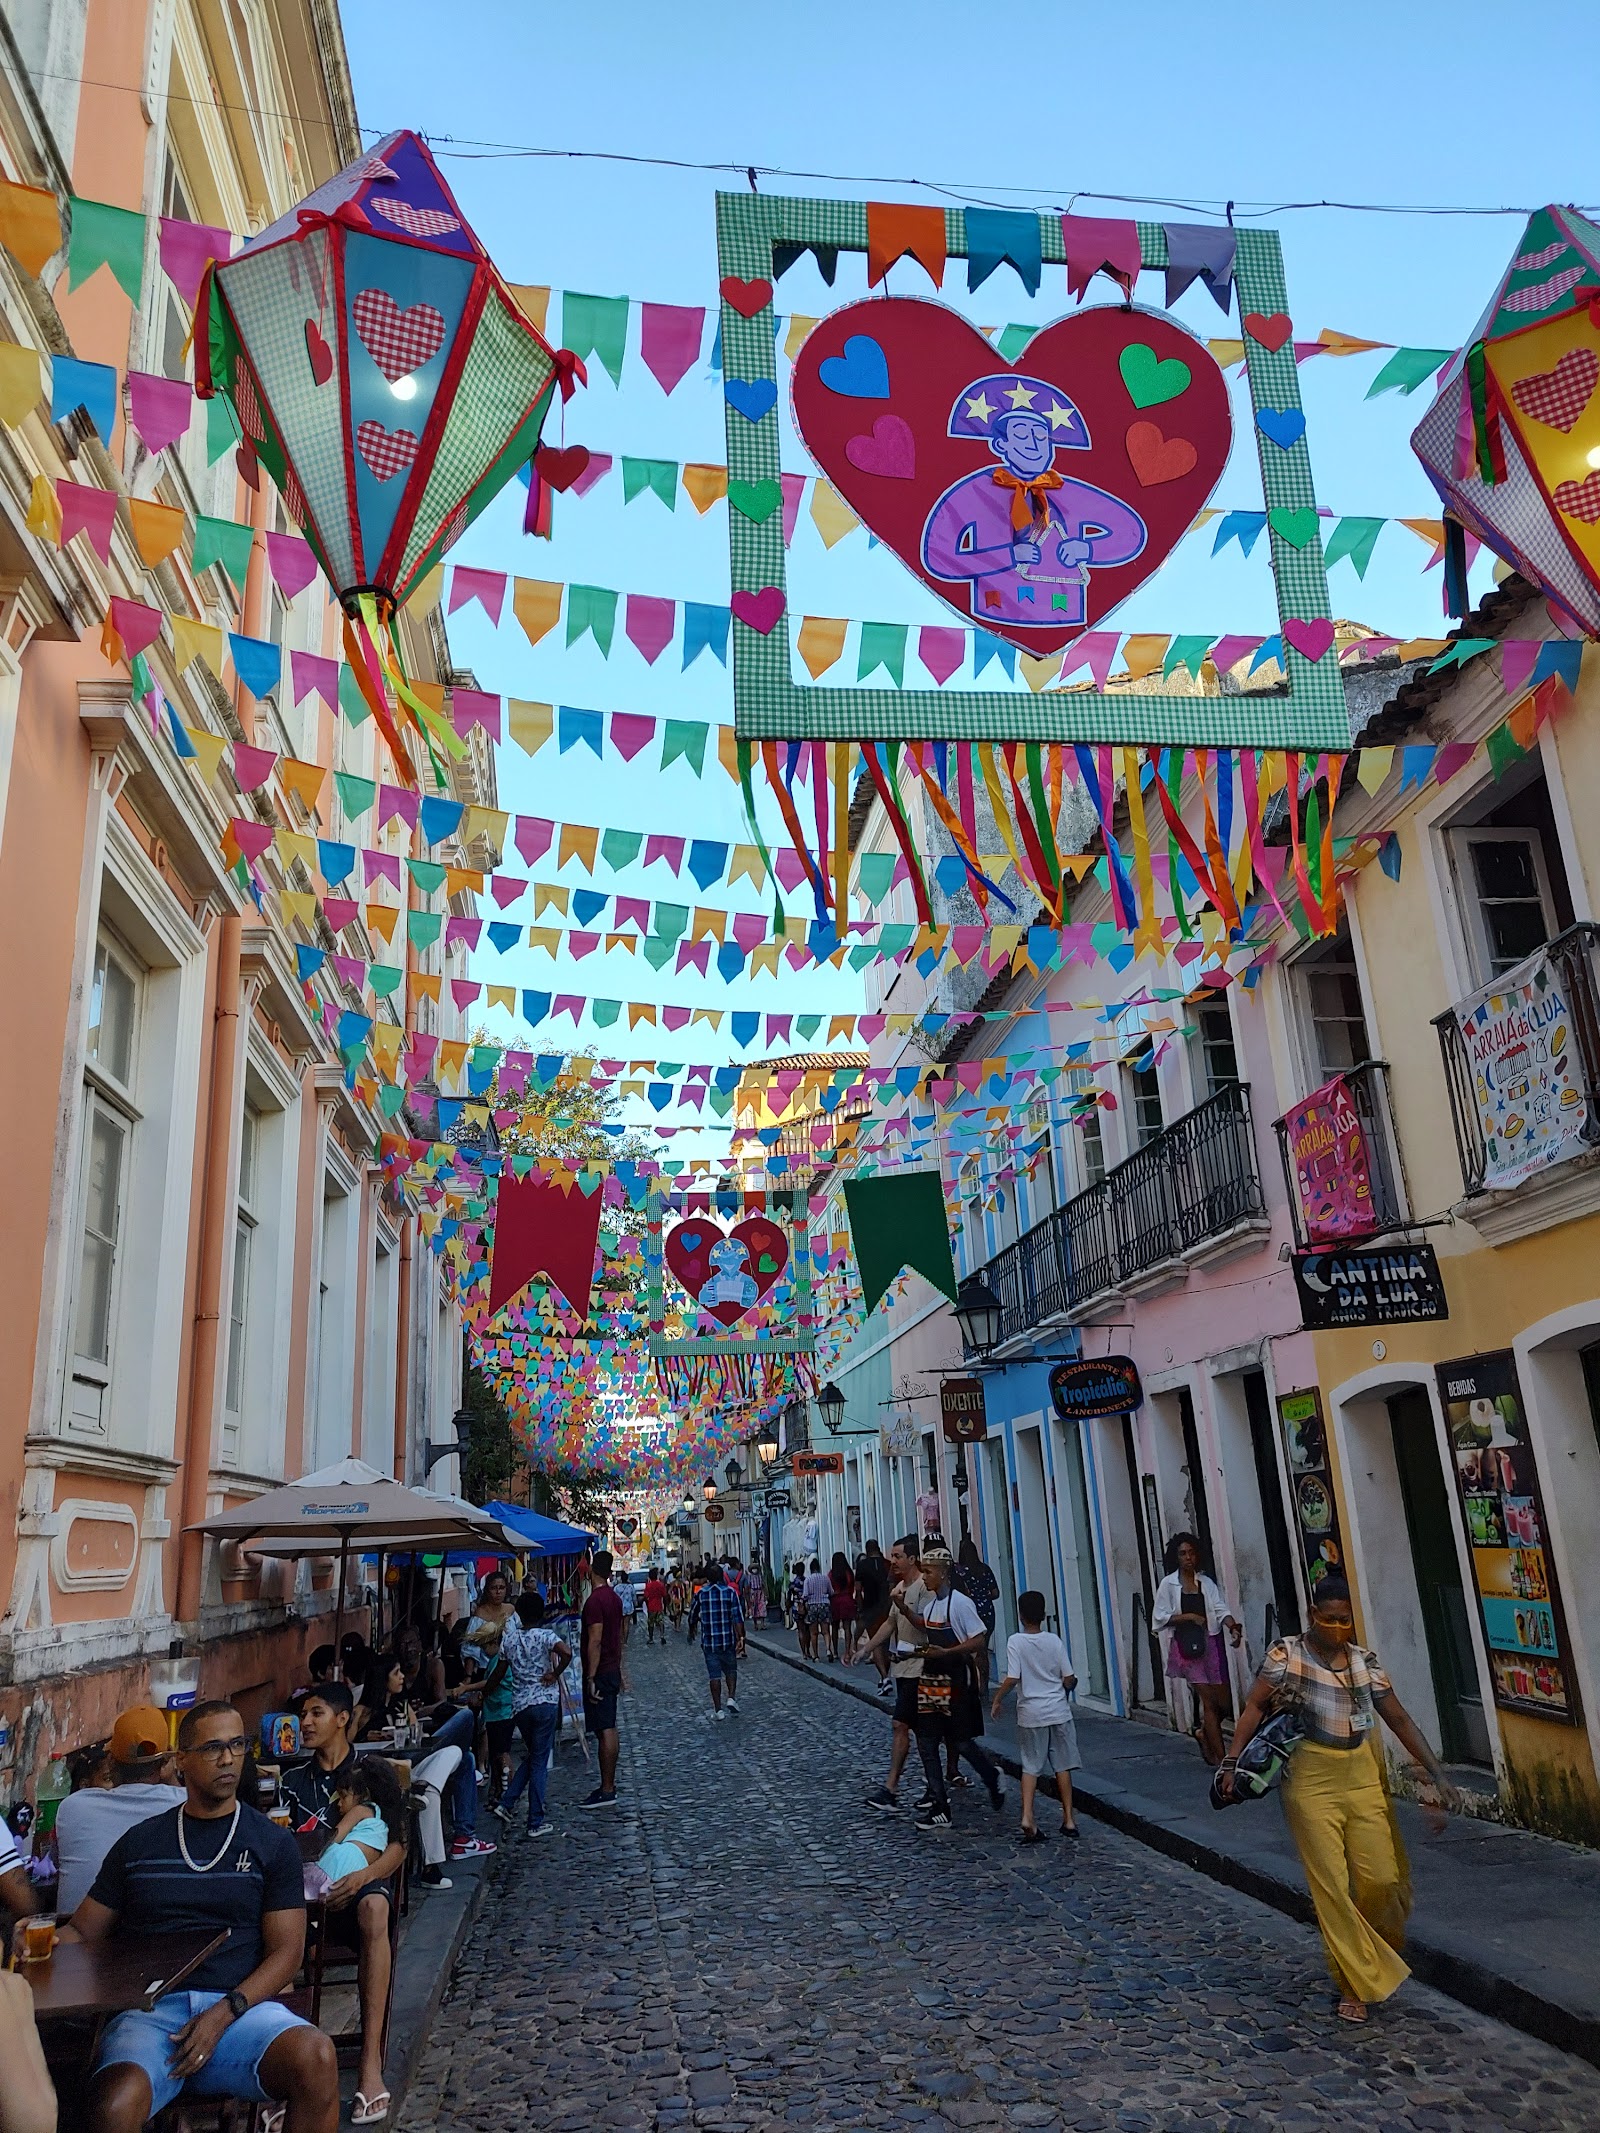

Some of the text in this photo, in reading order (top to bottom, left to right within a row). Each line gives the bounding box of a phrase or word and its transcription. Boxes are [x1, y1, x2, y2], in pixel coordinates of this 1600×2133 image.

[1473, 1012, 1522, 1065] ARRAIÁ
[1295, 1121, 1329, 1162] ARRAIÁ
[1337, 1282, 1419, 1307] DA LUA
[1330, 1306, 1367, 1322] ANOS
[1056, 1362, 1120, 1386] RESTAURANTE
[1060, 1375, 1127, 1407] Tropicália
[1447, 1378, 1477, 1397] BEBIDAS
[943, 1392, 984, 1412] OXENTE
[1065, 1397, 1135, 1416] LANCHONETE
